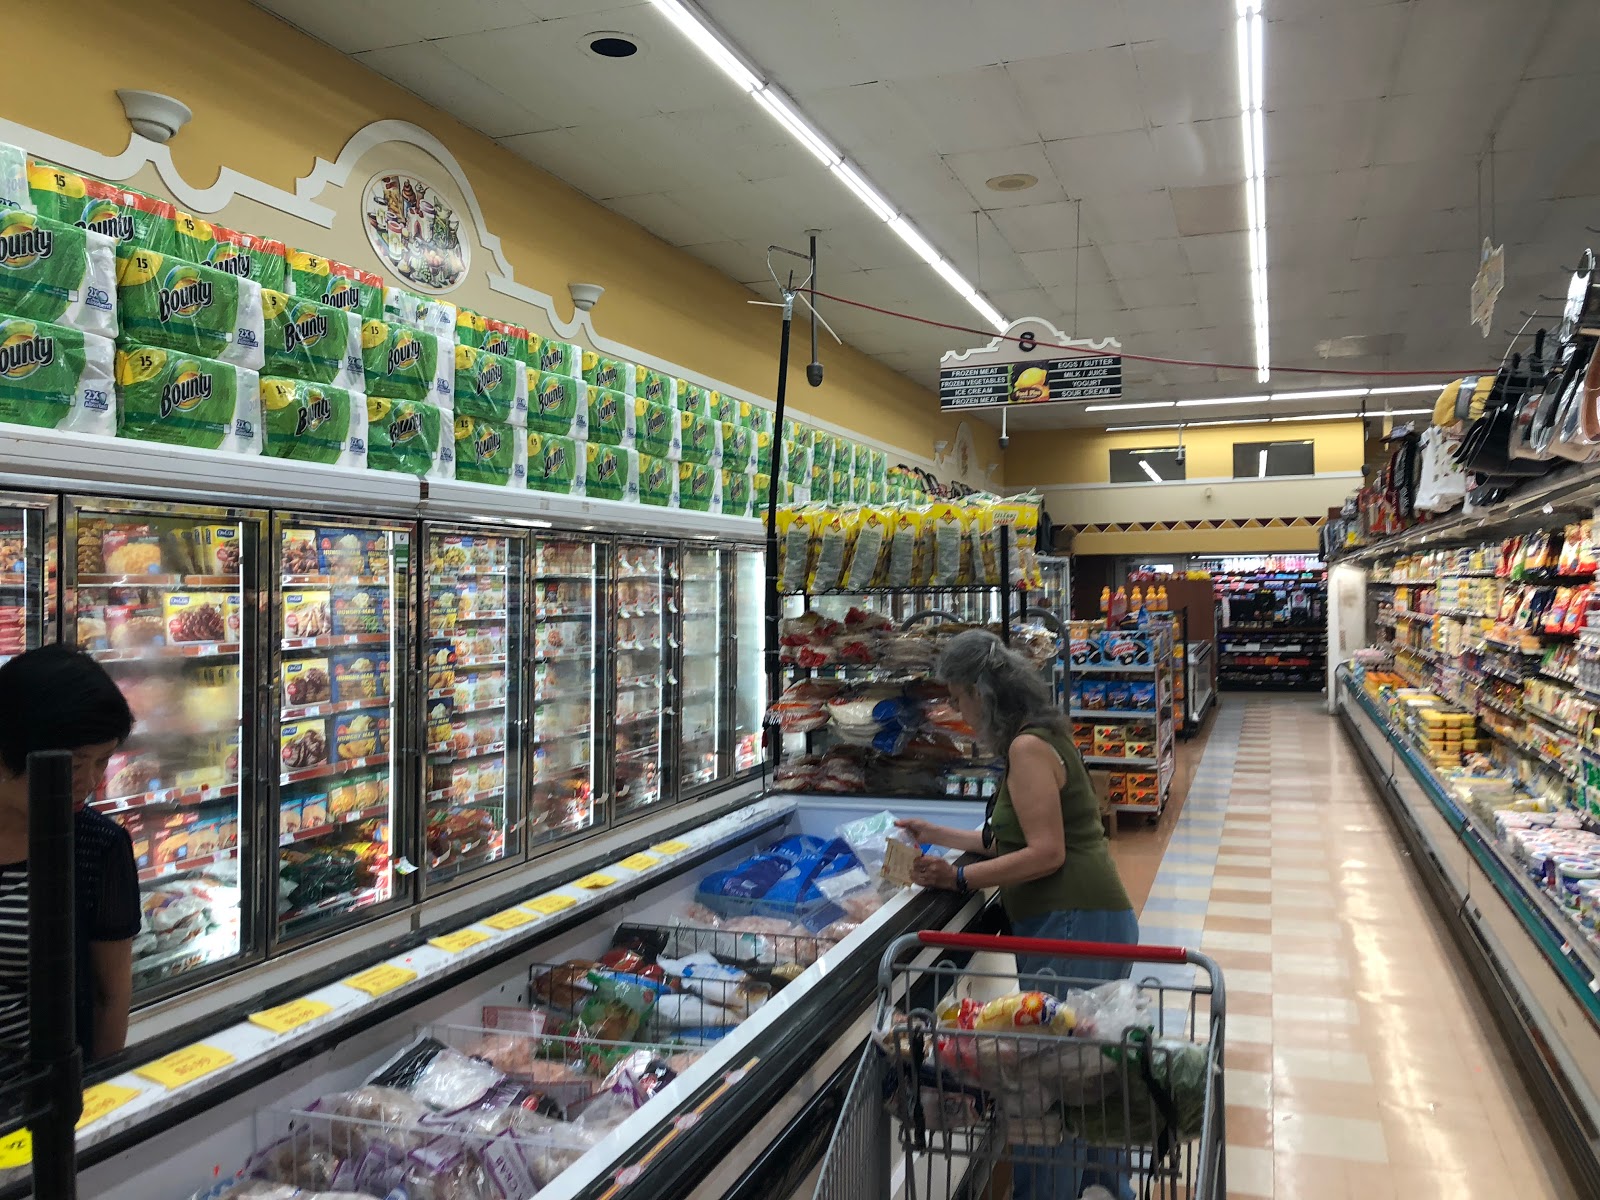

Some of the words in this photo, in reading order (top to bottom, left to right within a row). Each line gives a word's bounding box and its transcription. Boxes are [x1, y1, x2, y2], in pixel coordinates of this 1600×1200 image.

[54, 174, 66, 188] 15
[184, 219, 195, 231] 15
[136, 257, 149, 269] 15
[158, 279, 212, 324] Bounty
[284, 315, 327, 353] Bounty
[371, 326, 379, 335] 15
[1019, 332, 1036, 352] 8
[139, 355, 153, 367] 15
[387, 340, 421, 377] Bounty
[1057, 361, 1078, 369] EGGS
[1084, 358, 1114, 367] BUTTER
[951, 369, 979, 377] FROZEN
[980, 367, 999, 375] MEAT
[1063, 370, 1081, 378] MILK
[1087, 368, 1108, 376] JUICE
[966, 376, 1006, 386] VEGETABLES
[1072, 379, 1102, 387] YOGURT
[160, 372, 213, 419] Bounty
[967, 387, 993, 395] CREAM
[1061, 389, 1082, 398] SOUR
[1083, 387, 1111, 396] CREAM
[951, 397, 979, 405] FROZEN
